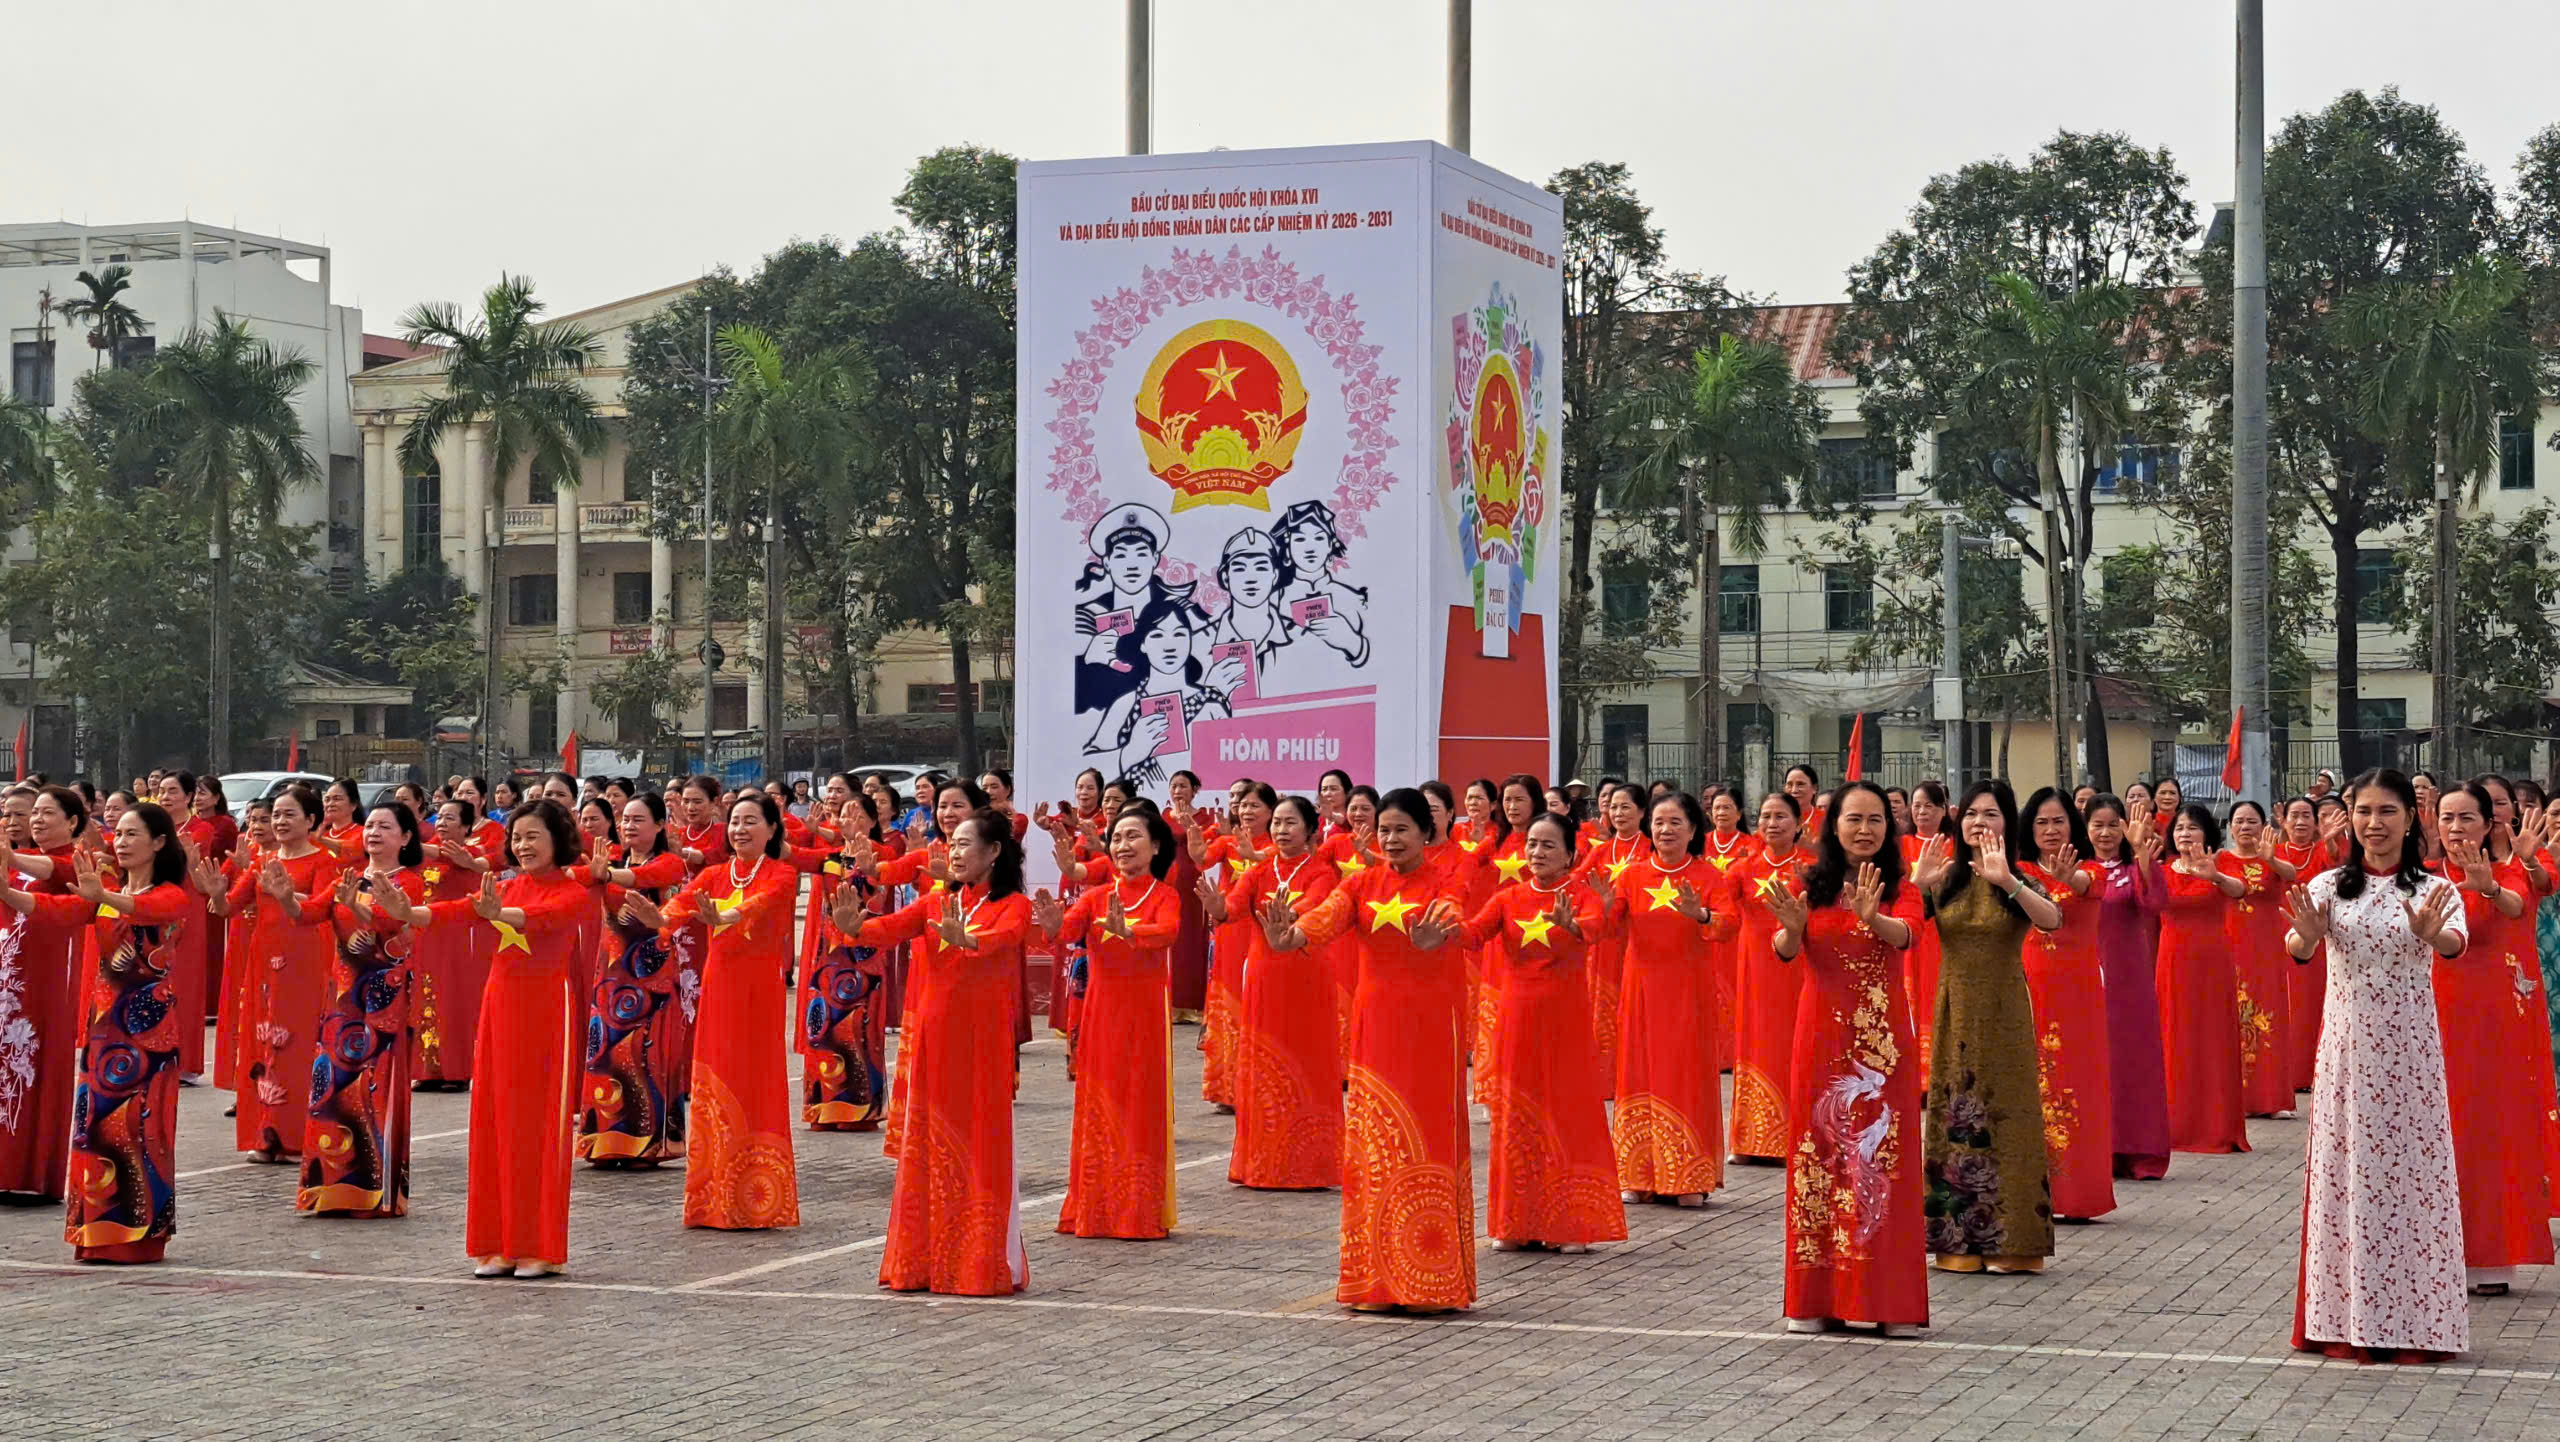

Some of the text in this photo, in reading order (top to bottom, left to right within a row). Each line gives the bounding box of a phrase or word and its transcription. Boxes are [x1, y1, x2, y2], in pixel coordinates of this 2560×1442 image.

[1155, 188, 1170, 211] CỬ
[1172, 194, 1189, 214] ĐẠI
[1192, 187, 1216, 209] BIỂU
[1219, 186, 1247, 210] QUỐC
[1250, 187, 1267, 210] HỘI
[1270, 186, 1298, 206] KHÓA
[1301, 188, 1318, 204] XVI
[1059, 222, 1073, 241] VÀ
[1076, 224, 1092, 244] ĐẠI
[1096, 217, 1119, 239] BIỂU
[1122, 218, 1139, 242] HỘI
[1173, 216, 1202, 236] NHÂN
[1205, 215, 1227, 234] DÂN
[1230, 214, 1250, 233] CÁC
[1254, 210, 1275, 232] CẤP
[1278, 211, 1312, 235] NHIỆM
[1315, 209, 1329, 230] KỲ
[1331, 212, 1357, 229] 2026
[1368, 210, 1392, 227] 2031
[1221, 478, 1246, 489] NAM
[1219, 729, 1340, 761] HÒM PHIẾU
